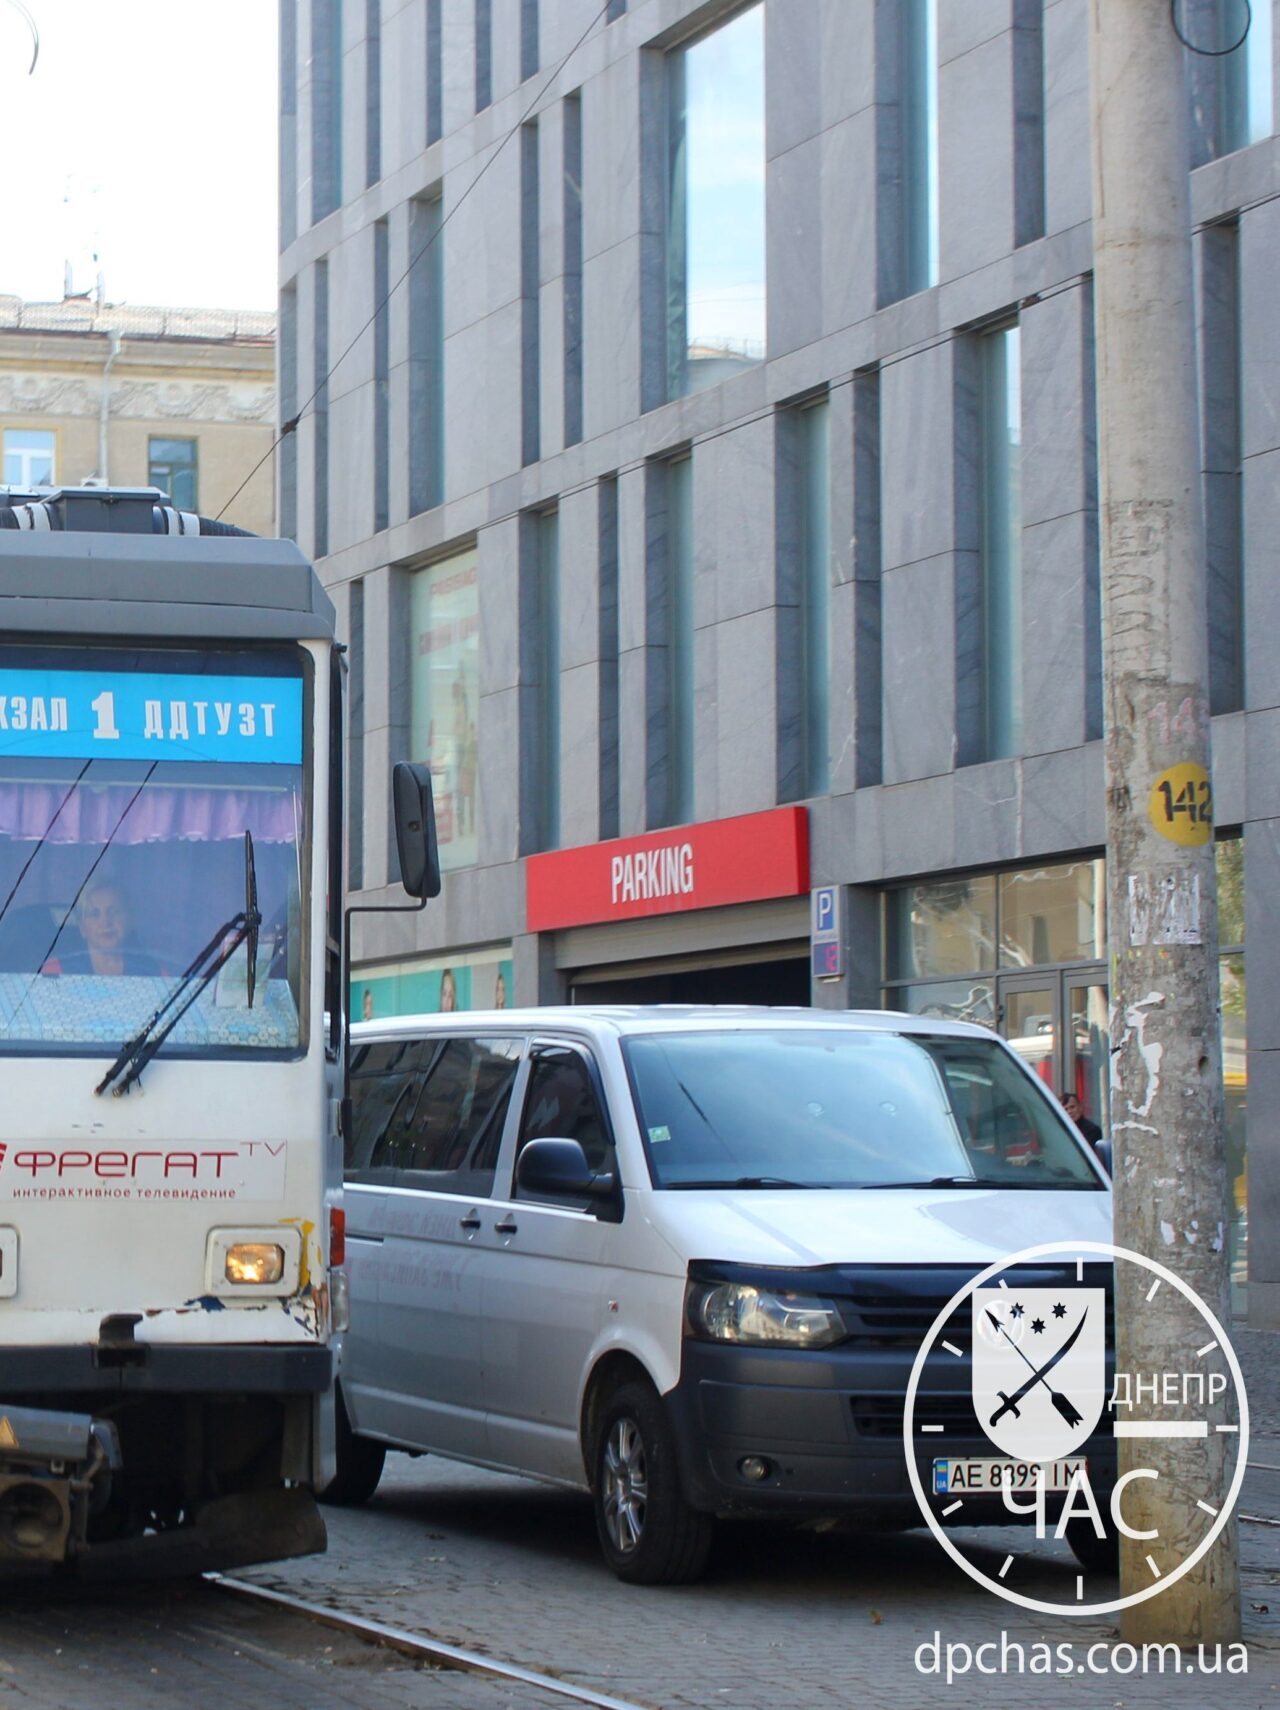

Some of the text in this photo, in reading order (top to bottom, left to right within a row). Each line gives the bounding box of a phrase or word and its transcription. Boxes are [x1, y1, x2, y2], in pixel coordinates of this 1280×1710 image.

[91, 691, 120, 740] 1
[144, 700, 276, 740] ДДТУЗТ
[1158, 779, 1213, 824] 142
[611, 843, 694, 905] PARKING
[819, 893, 832, 929] P
[14, 1141, 286, 1178] ФРЕГАТ TV
[13, 1188, 236, 1200] интерактивное телевидение
[951, 1464, 982, 1488] AE
